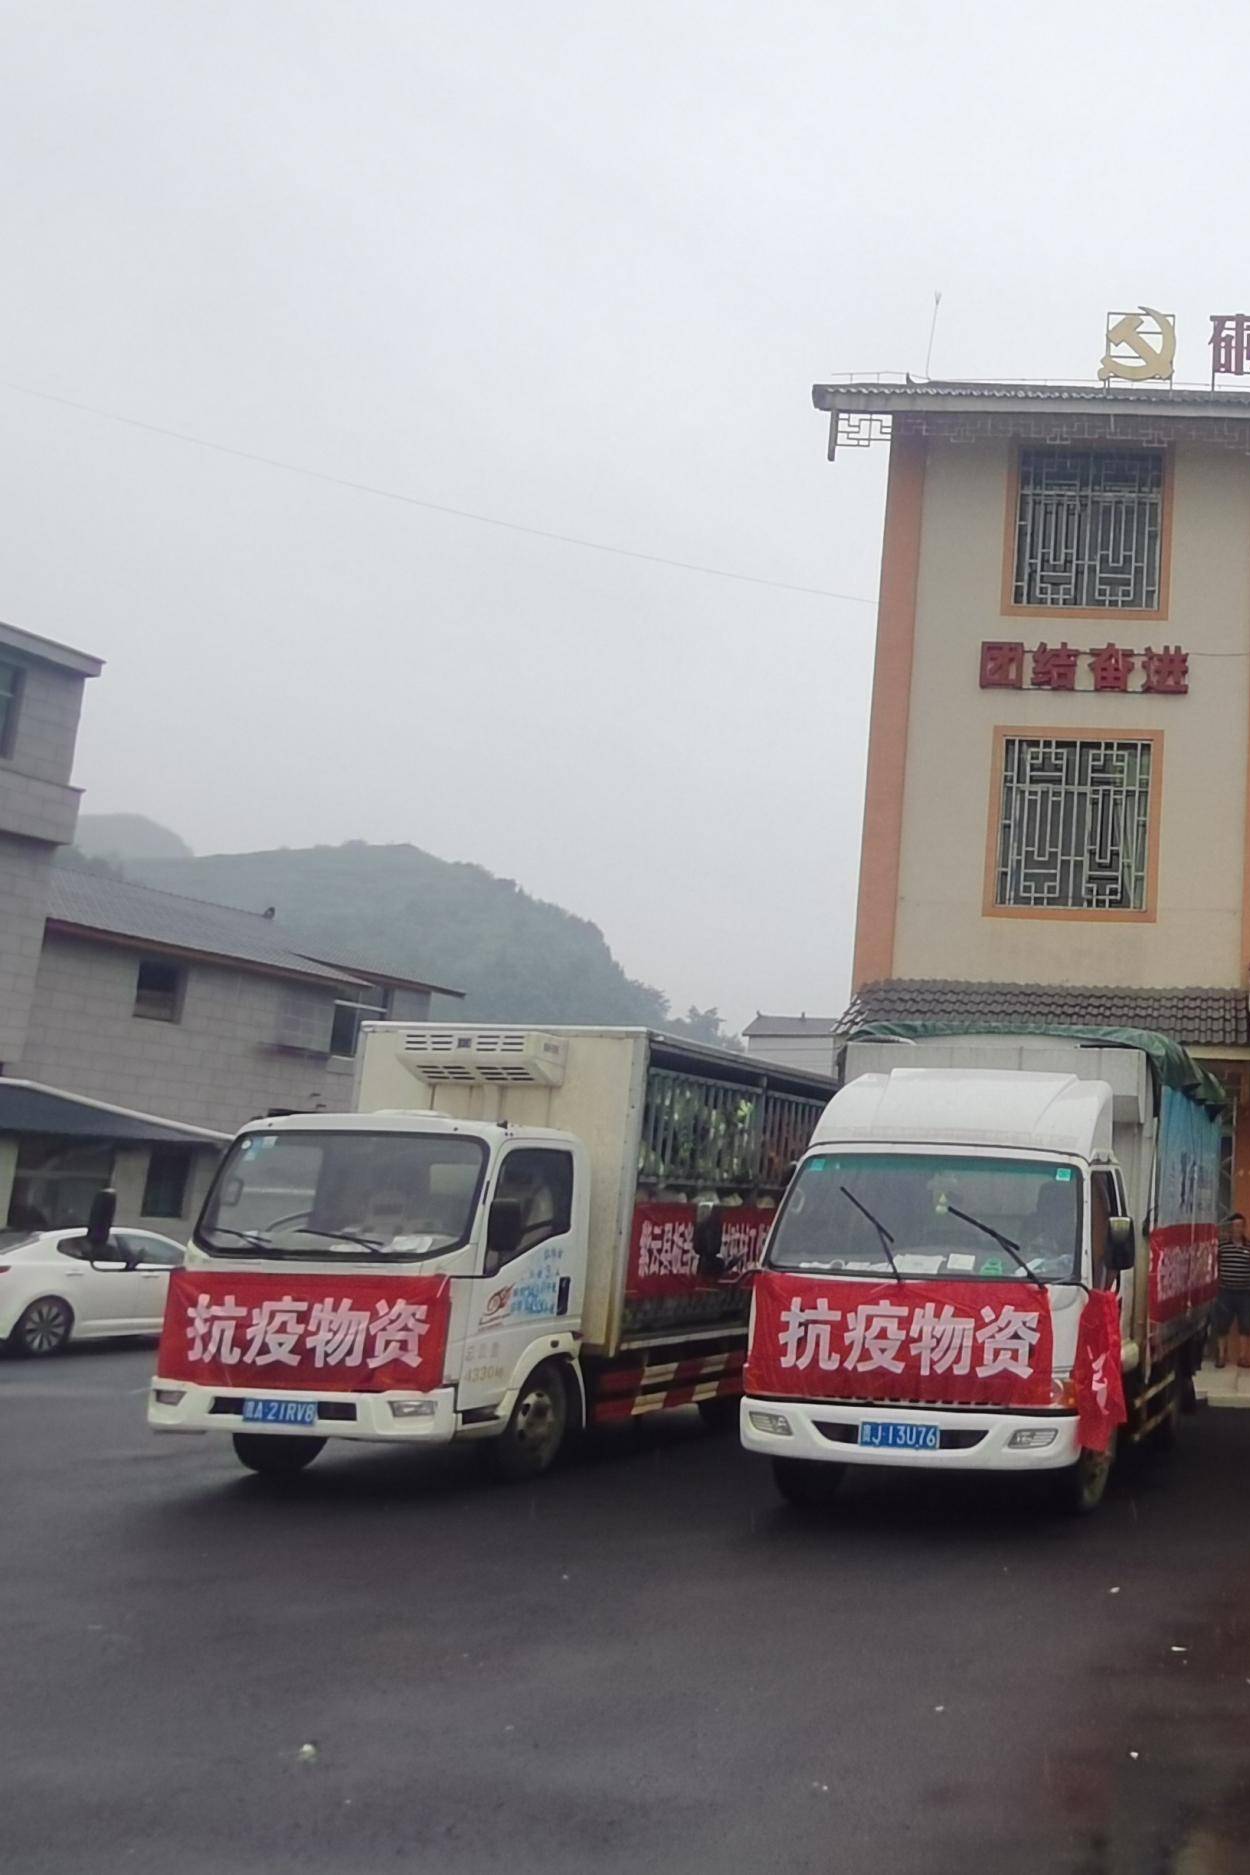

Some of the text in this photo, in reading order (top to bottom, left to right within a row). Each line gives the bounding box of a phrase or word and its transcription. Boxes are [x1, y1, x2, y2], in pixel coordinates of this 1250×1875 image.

[980, 641, 1188, 695] 团结奋进
[186, 1293, 430, 1368] 抗疫物资
[778, 1296, 1041, 1380] 抗疫物资
